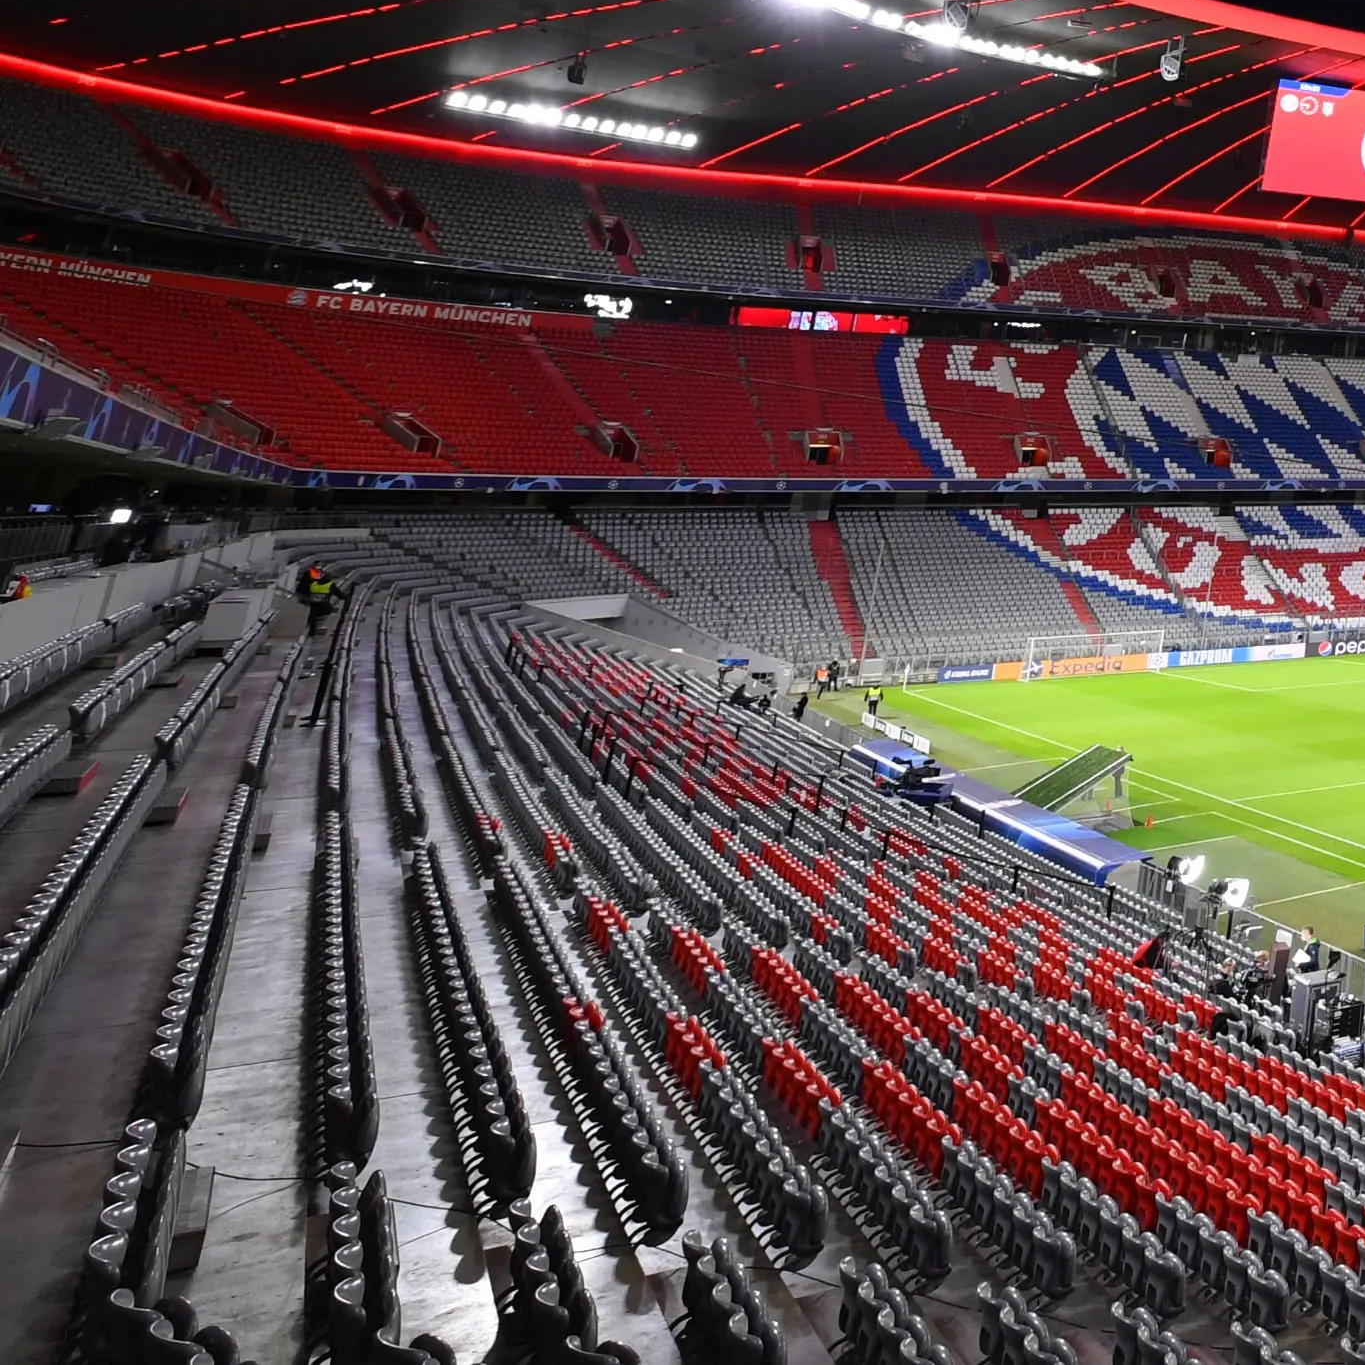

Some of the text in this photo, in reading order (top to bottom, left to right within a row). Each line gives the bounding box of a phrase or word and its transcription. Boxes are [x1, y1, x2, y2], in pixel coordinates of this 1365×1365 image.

[0, 253, 152, 287] YERN MÜNCHEN
[316, 295, 532, 326] FC BAYERN MÜNCHEN
[1052, 659, 1123, 676] Expedia
[1180, 648, 1233, 666] GAZPROM
